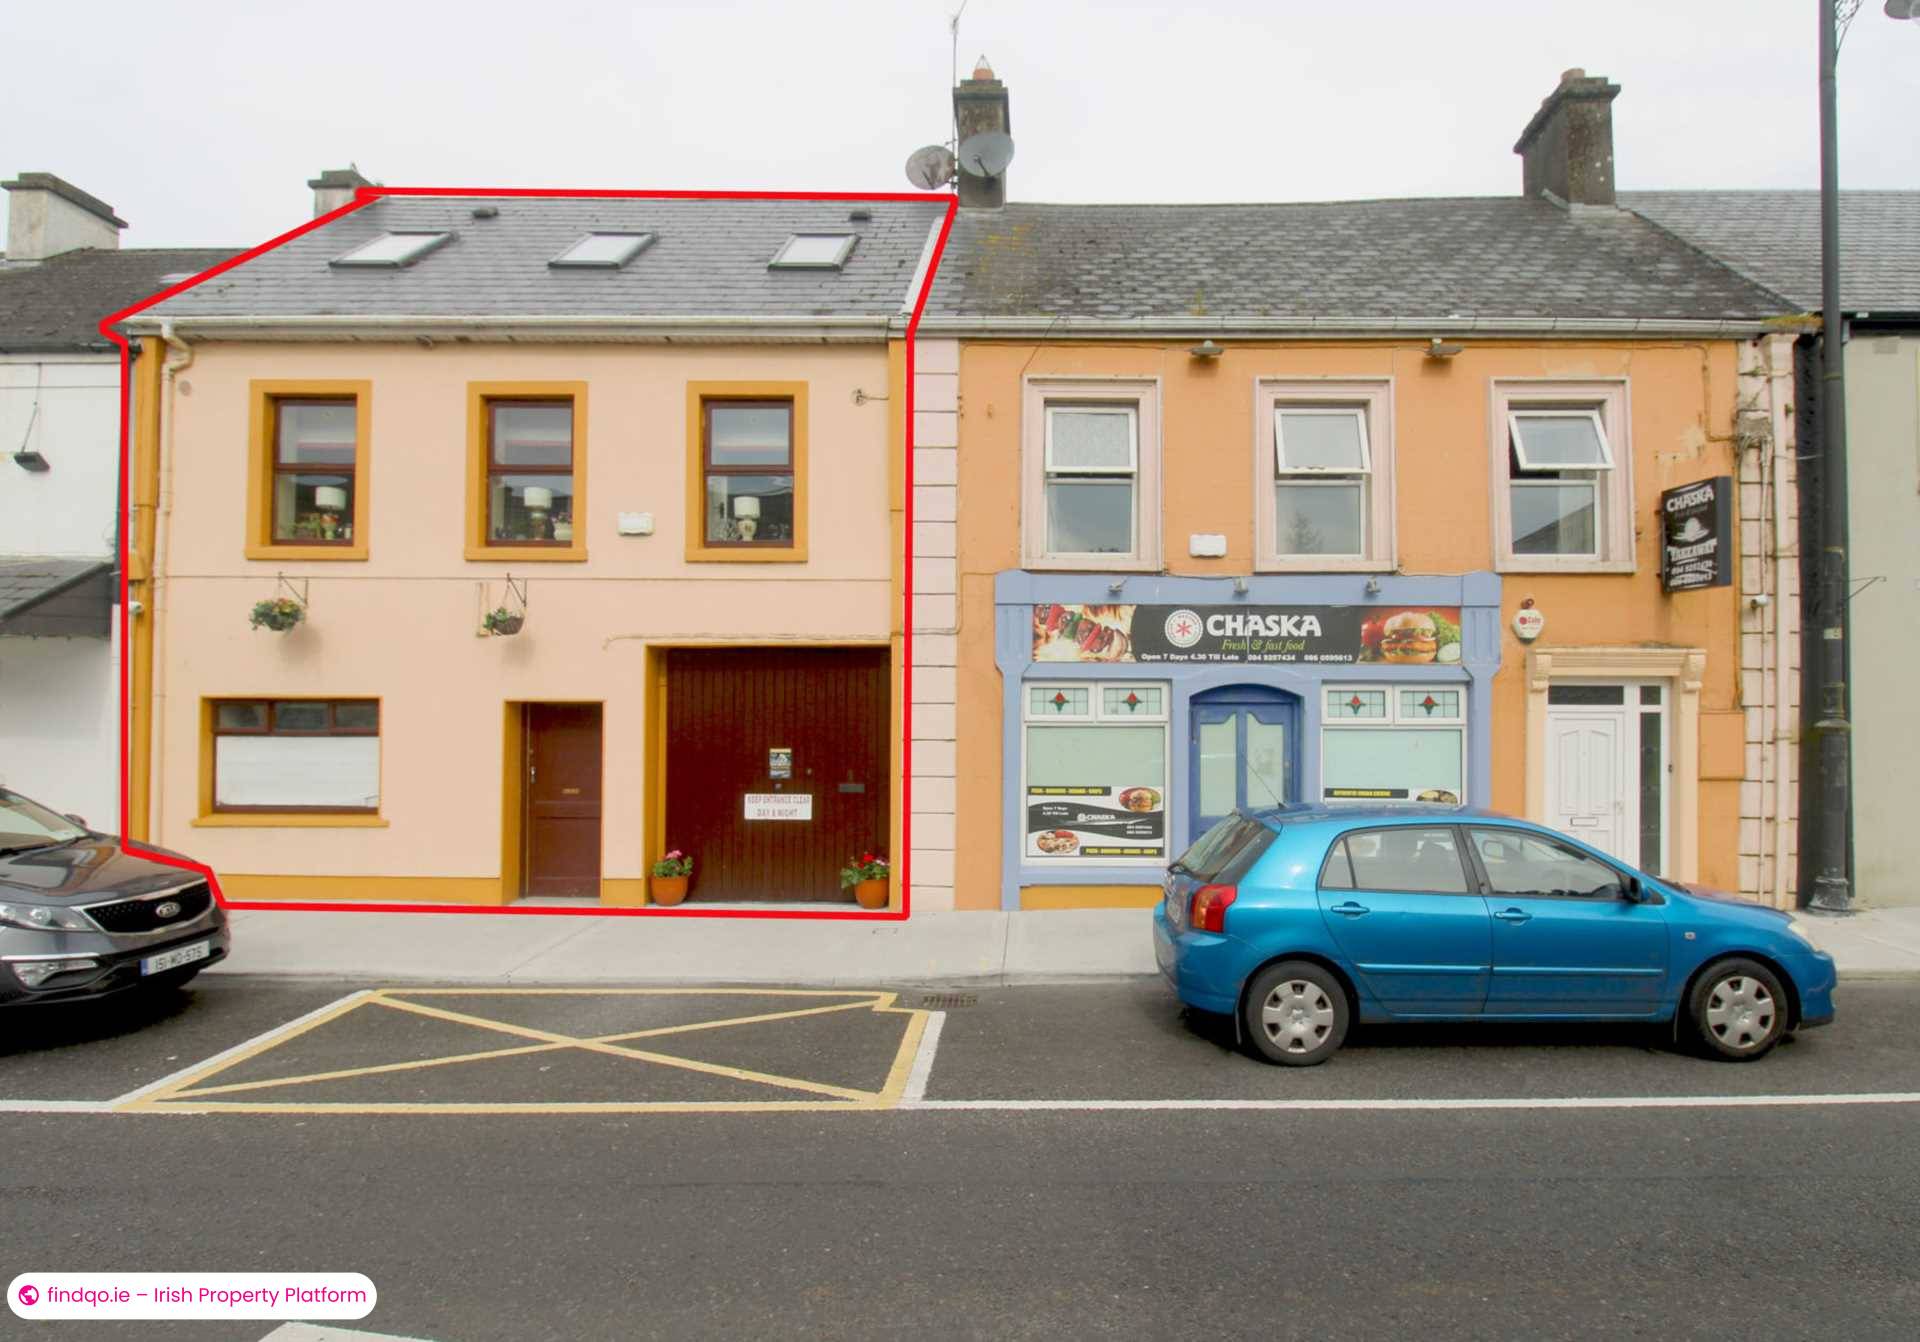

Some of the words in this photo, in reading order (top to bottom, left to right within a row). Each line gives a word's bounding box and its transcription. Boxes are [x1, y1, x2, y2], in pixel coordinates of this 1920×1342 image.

[1666, 484, 1715, 512] CHASKA
[1206, 614, 1323, 637] CHASKA
[1221, 639, 1248, 650] Fresh
[1251, 640, 1262, 650] &
[1263, 640, 1282, 653] fast
[1282, 639, 1306, 653] food
[1140, 653, 1161, 661] Open
[1169, 653, 1189, 661] Days
[1221, 653, 1240, 661] Late
